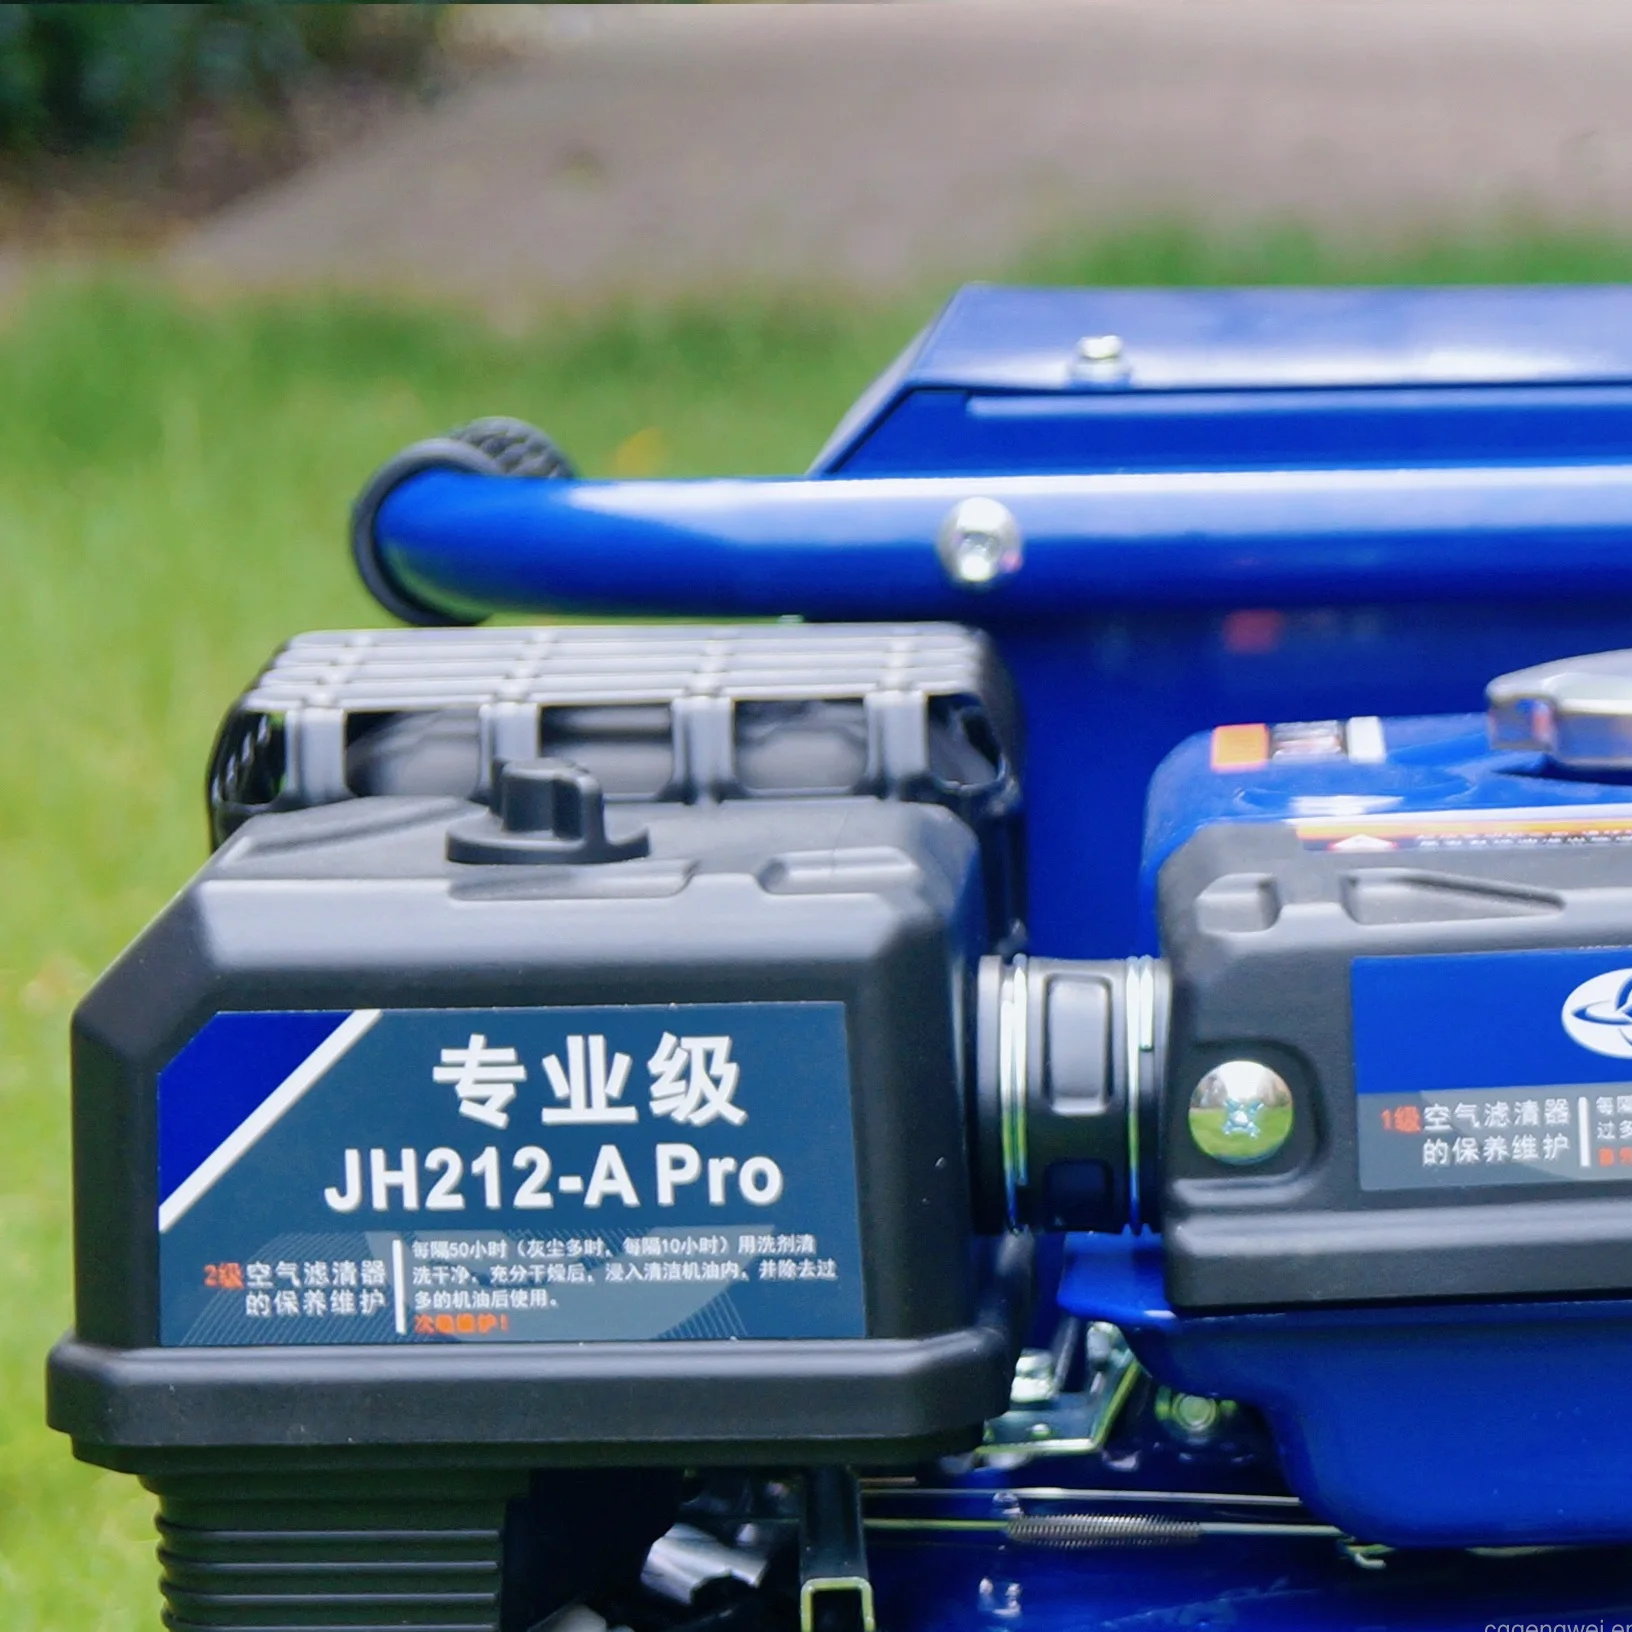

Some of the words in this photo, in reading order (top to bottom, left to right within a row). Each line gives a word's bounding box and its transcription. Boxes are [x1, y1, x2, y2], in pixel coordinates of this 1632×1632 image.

[432, 1031, 748, 1130] 专业级
[1422, 1132, 1570, 1167] 的保养维护
[323, 1143, 641, 1212] JH212-A
[655, 1142, 784, 1207] Pro
[245, 1289, 386, 1318] 的保养维护
